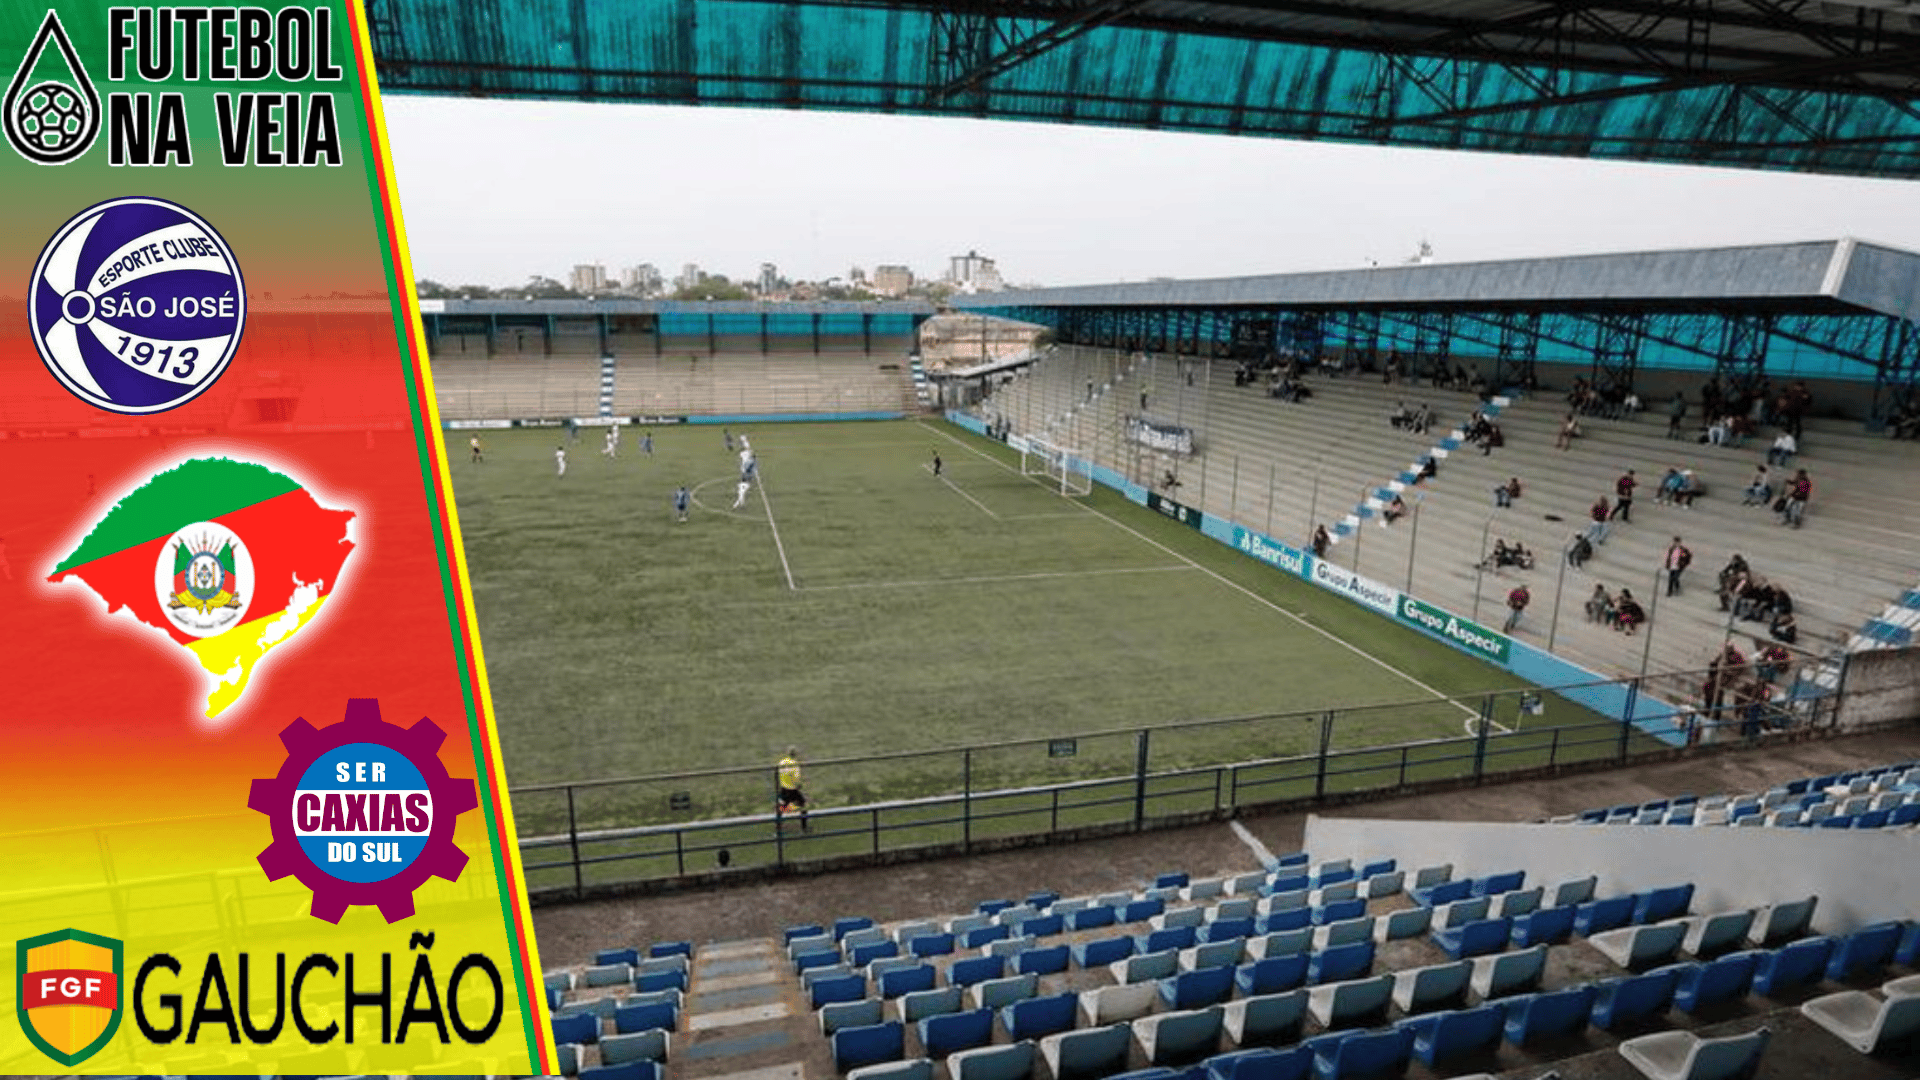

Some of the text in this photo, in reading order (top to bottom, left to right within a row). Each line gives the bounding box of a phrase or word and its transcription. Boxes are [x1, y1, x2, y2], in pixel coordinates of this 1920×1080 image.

[1252, 535, 1304, 573] Banrisul
[1404, 600, 1503, 654] Grupo Aspecir
